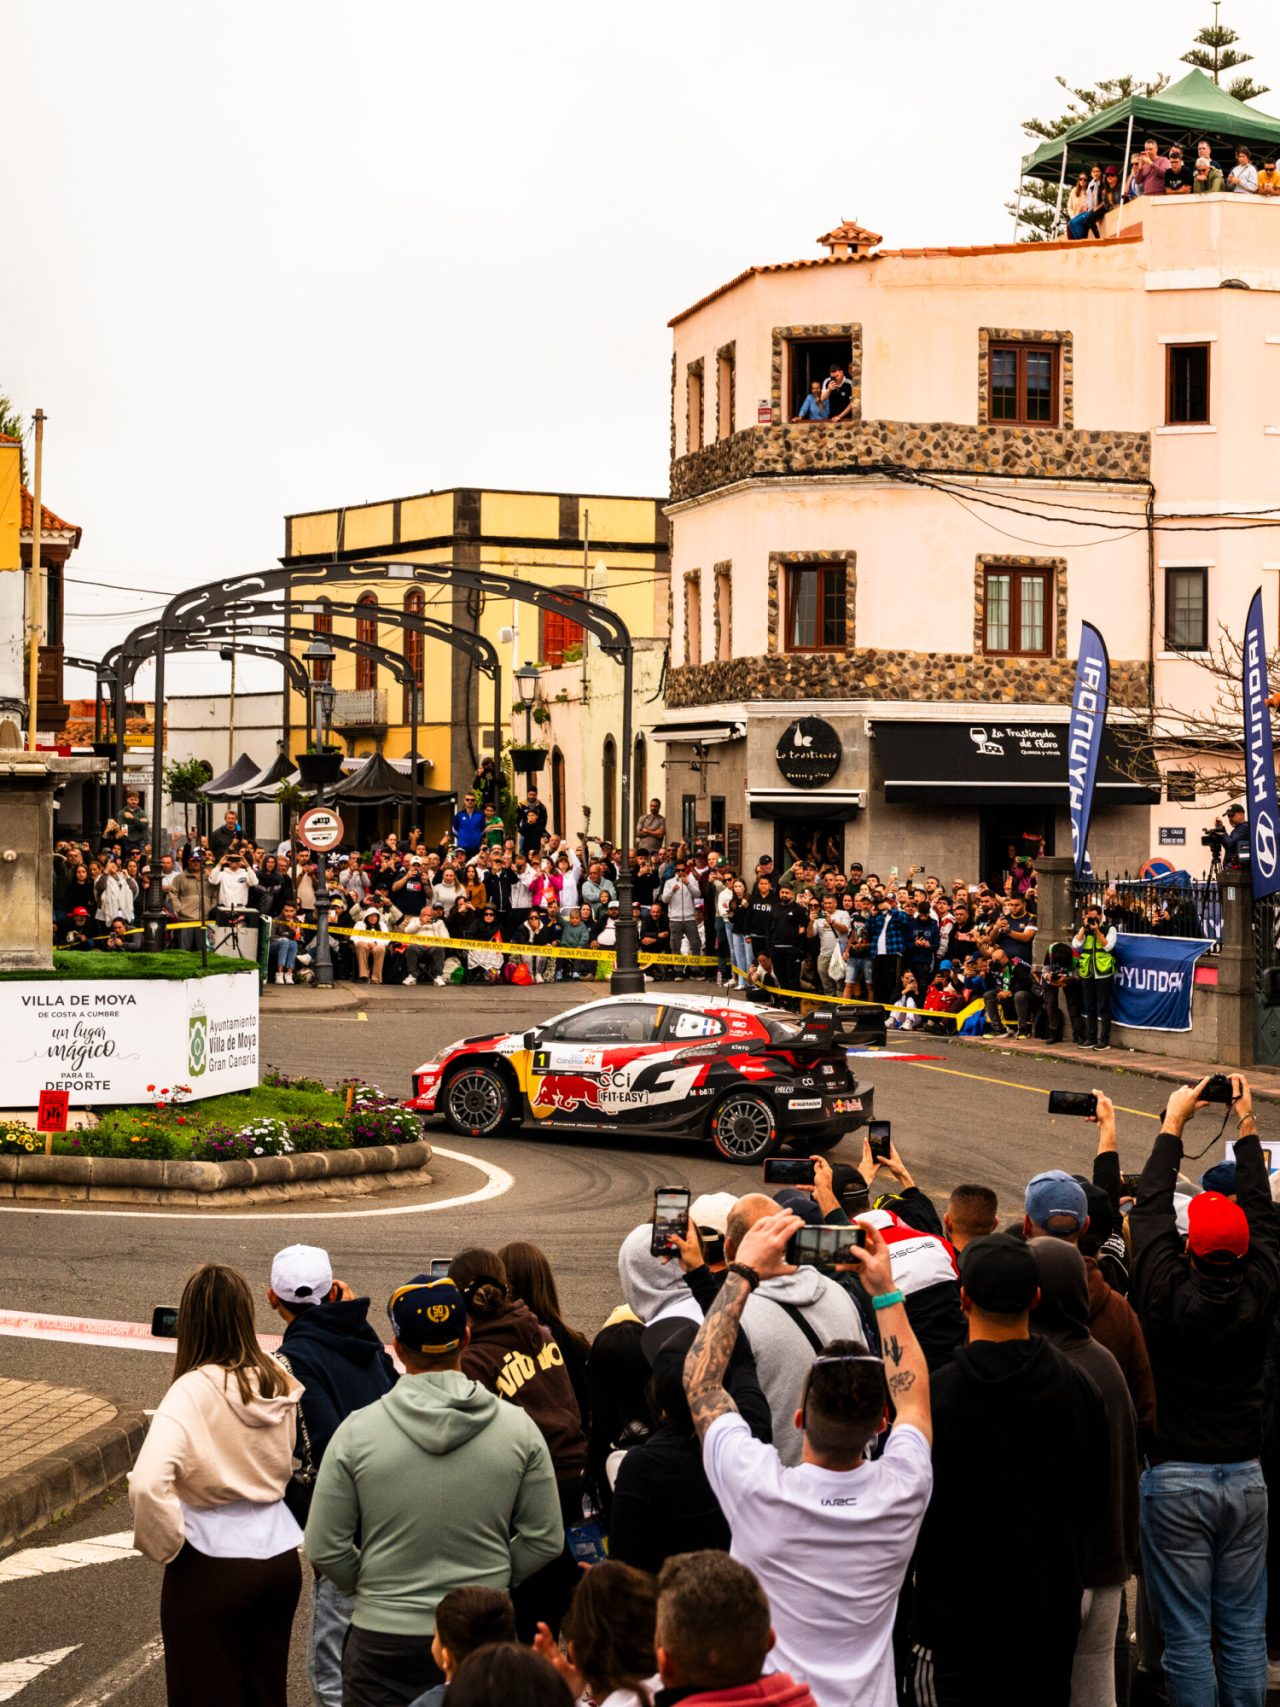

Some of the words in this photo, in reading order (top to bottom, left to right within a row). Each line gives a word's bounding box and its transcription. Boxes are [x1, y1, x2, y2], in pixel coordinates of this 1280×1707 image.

[1247, 628, 1268, 803] HYUNDAI
[1005, 728, 1057, 738] Trastienda
[1019, 738, 1032, 748] de
[753, 903, 772, 912] ICON
[358, 929, 376, 937] ZONA
[459, 940, 477, 948] ZONA
[477, 941, 504, 951] PUBLICO
[559, 949, 576, 957] ZONA
[576, 950, 602, 959] PUBLICO
[656, 955, 673, 963] ZONA
[673, 956, 700, 965] PUBLICO
[21, 995, 65, 1006] VILLA
[70, 995, 90, 1006] DE
[94, 994, 137, 1006] MOYA
[86, 1010, 120, 1018] CUMBRE
[209, 1015, 257, 1036] Ayuntamiento
[52, 1028, 69, 1039] un
[73, 1020, 107, 1045] lugar
[209, 1037, 225, 1053] Villa
[227, 1036, 236, 1051] de
[237, 1032, 257, 1050] Moya
[209, 1057, 226, 1072] Gran
[228, 1053, 256, 1070] Canaria
[537, 1053, 545, 1067] 1
[45, 1080, 111, 1091] DEPORTE
[432, 1304, 443, 1314] 50
[821, 1497, 857, 1506] WRC
